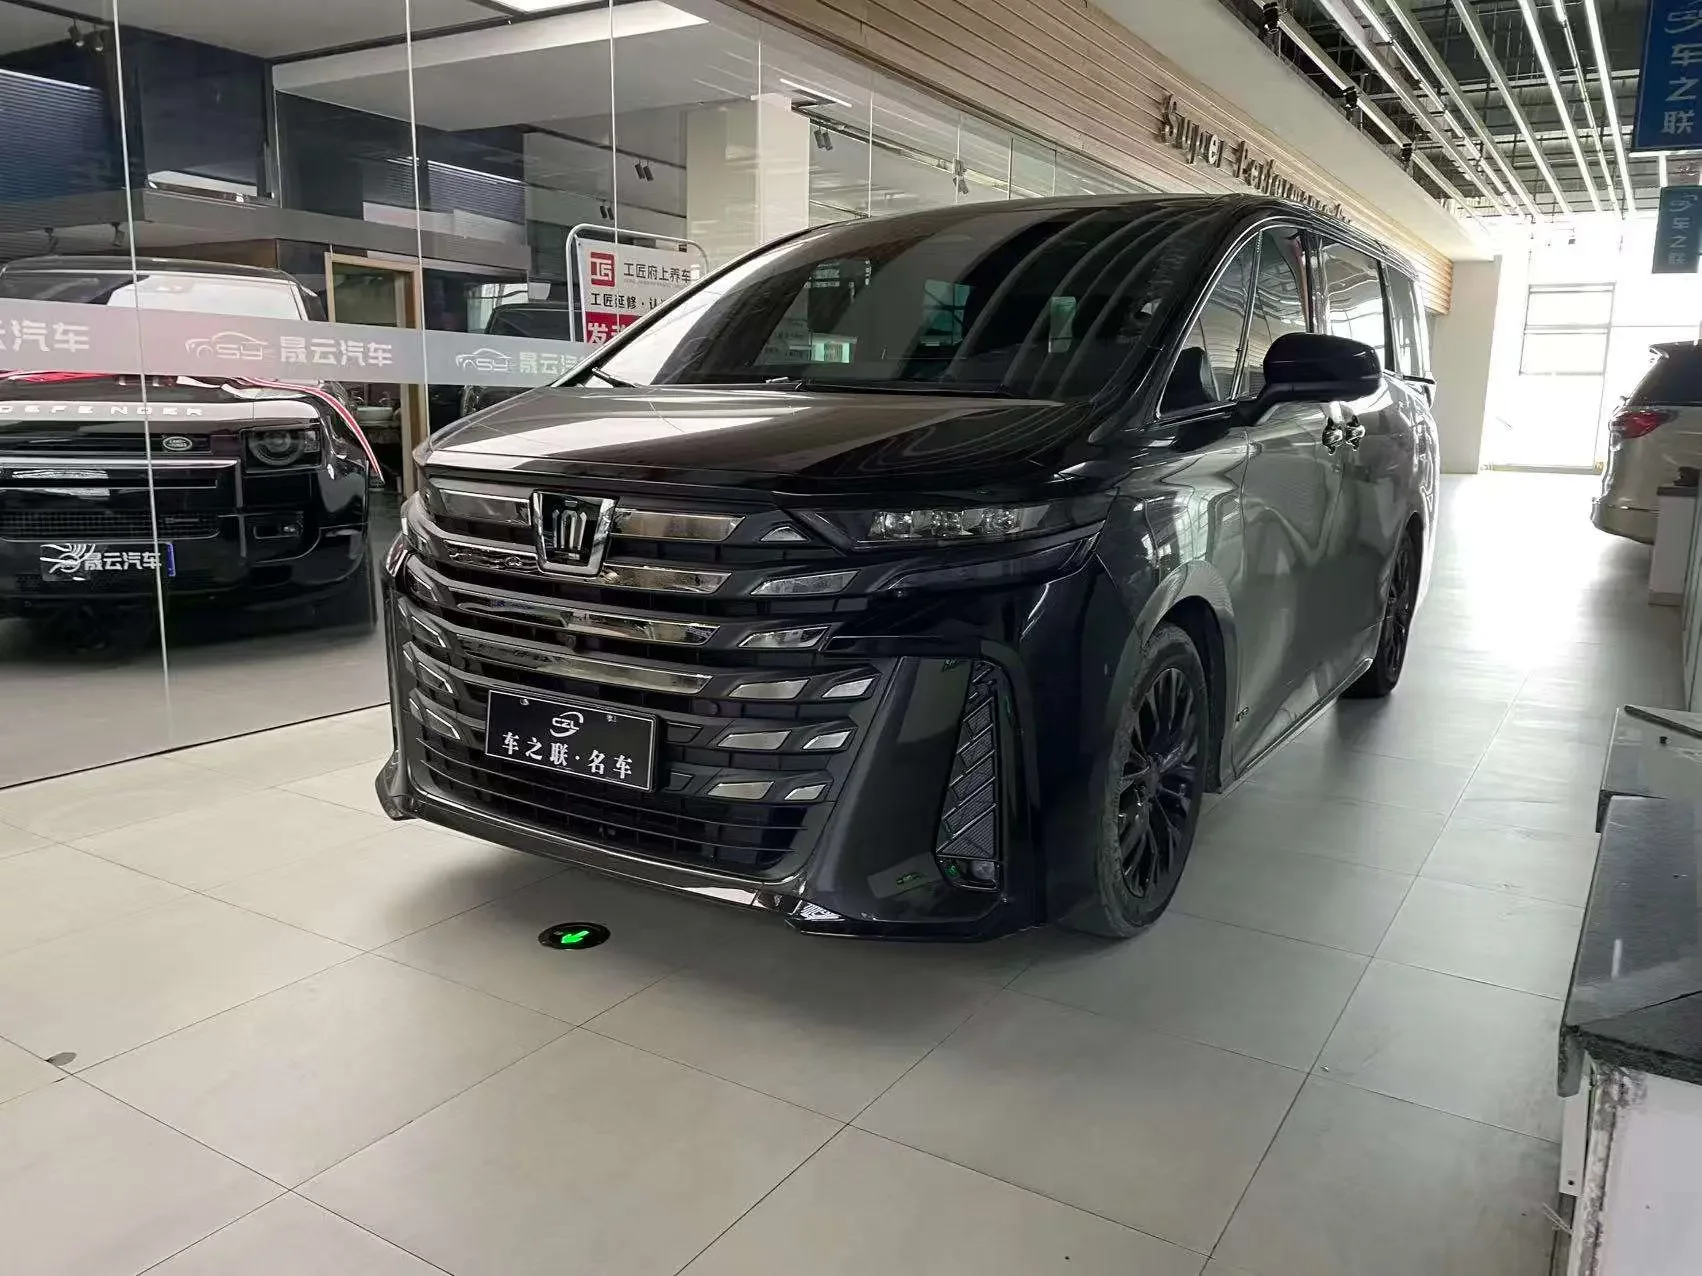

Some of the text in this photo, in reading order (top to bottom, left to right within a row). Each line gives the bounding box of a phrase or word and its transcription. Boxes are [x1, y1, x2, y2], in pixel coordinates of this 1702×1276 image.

[1662, 43, 1702, 134] 车之联
[623, 262, 691, 283] 工匠府上养车
[279, 335, 393, 367] 晟云汽车
[519, 351, 584, 375] 晟云汽
[0, 404, 202, 416] DEFENDER
[552, 717, 579, 730] CZL
[502, 731, 633, 779] 车之联·名车
